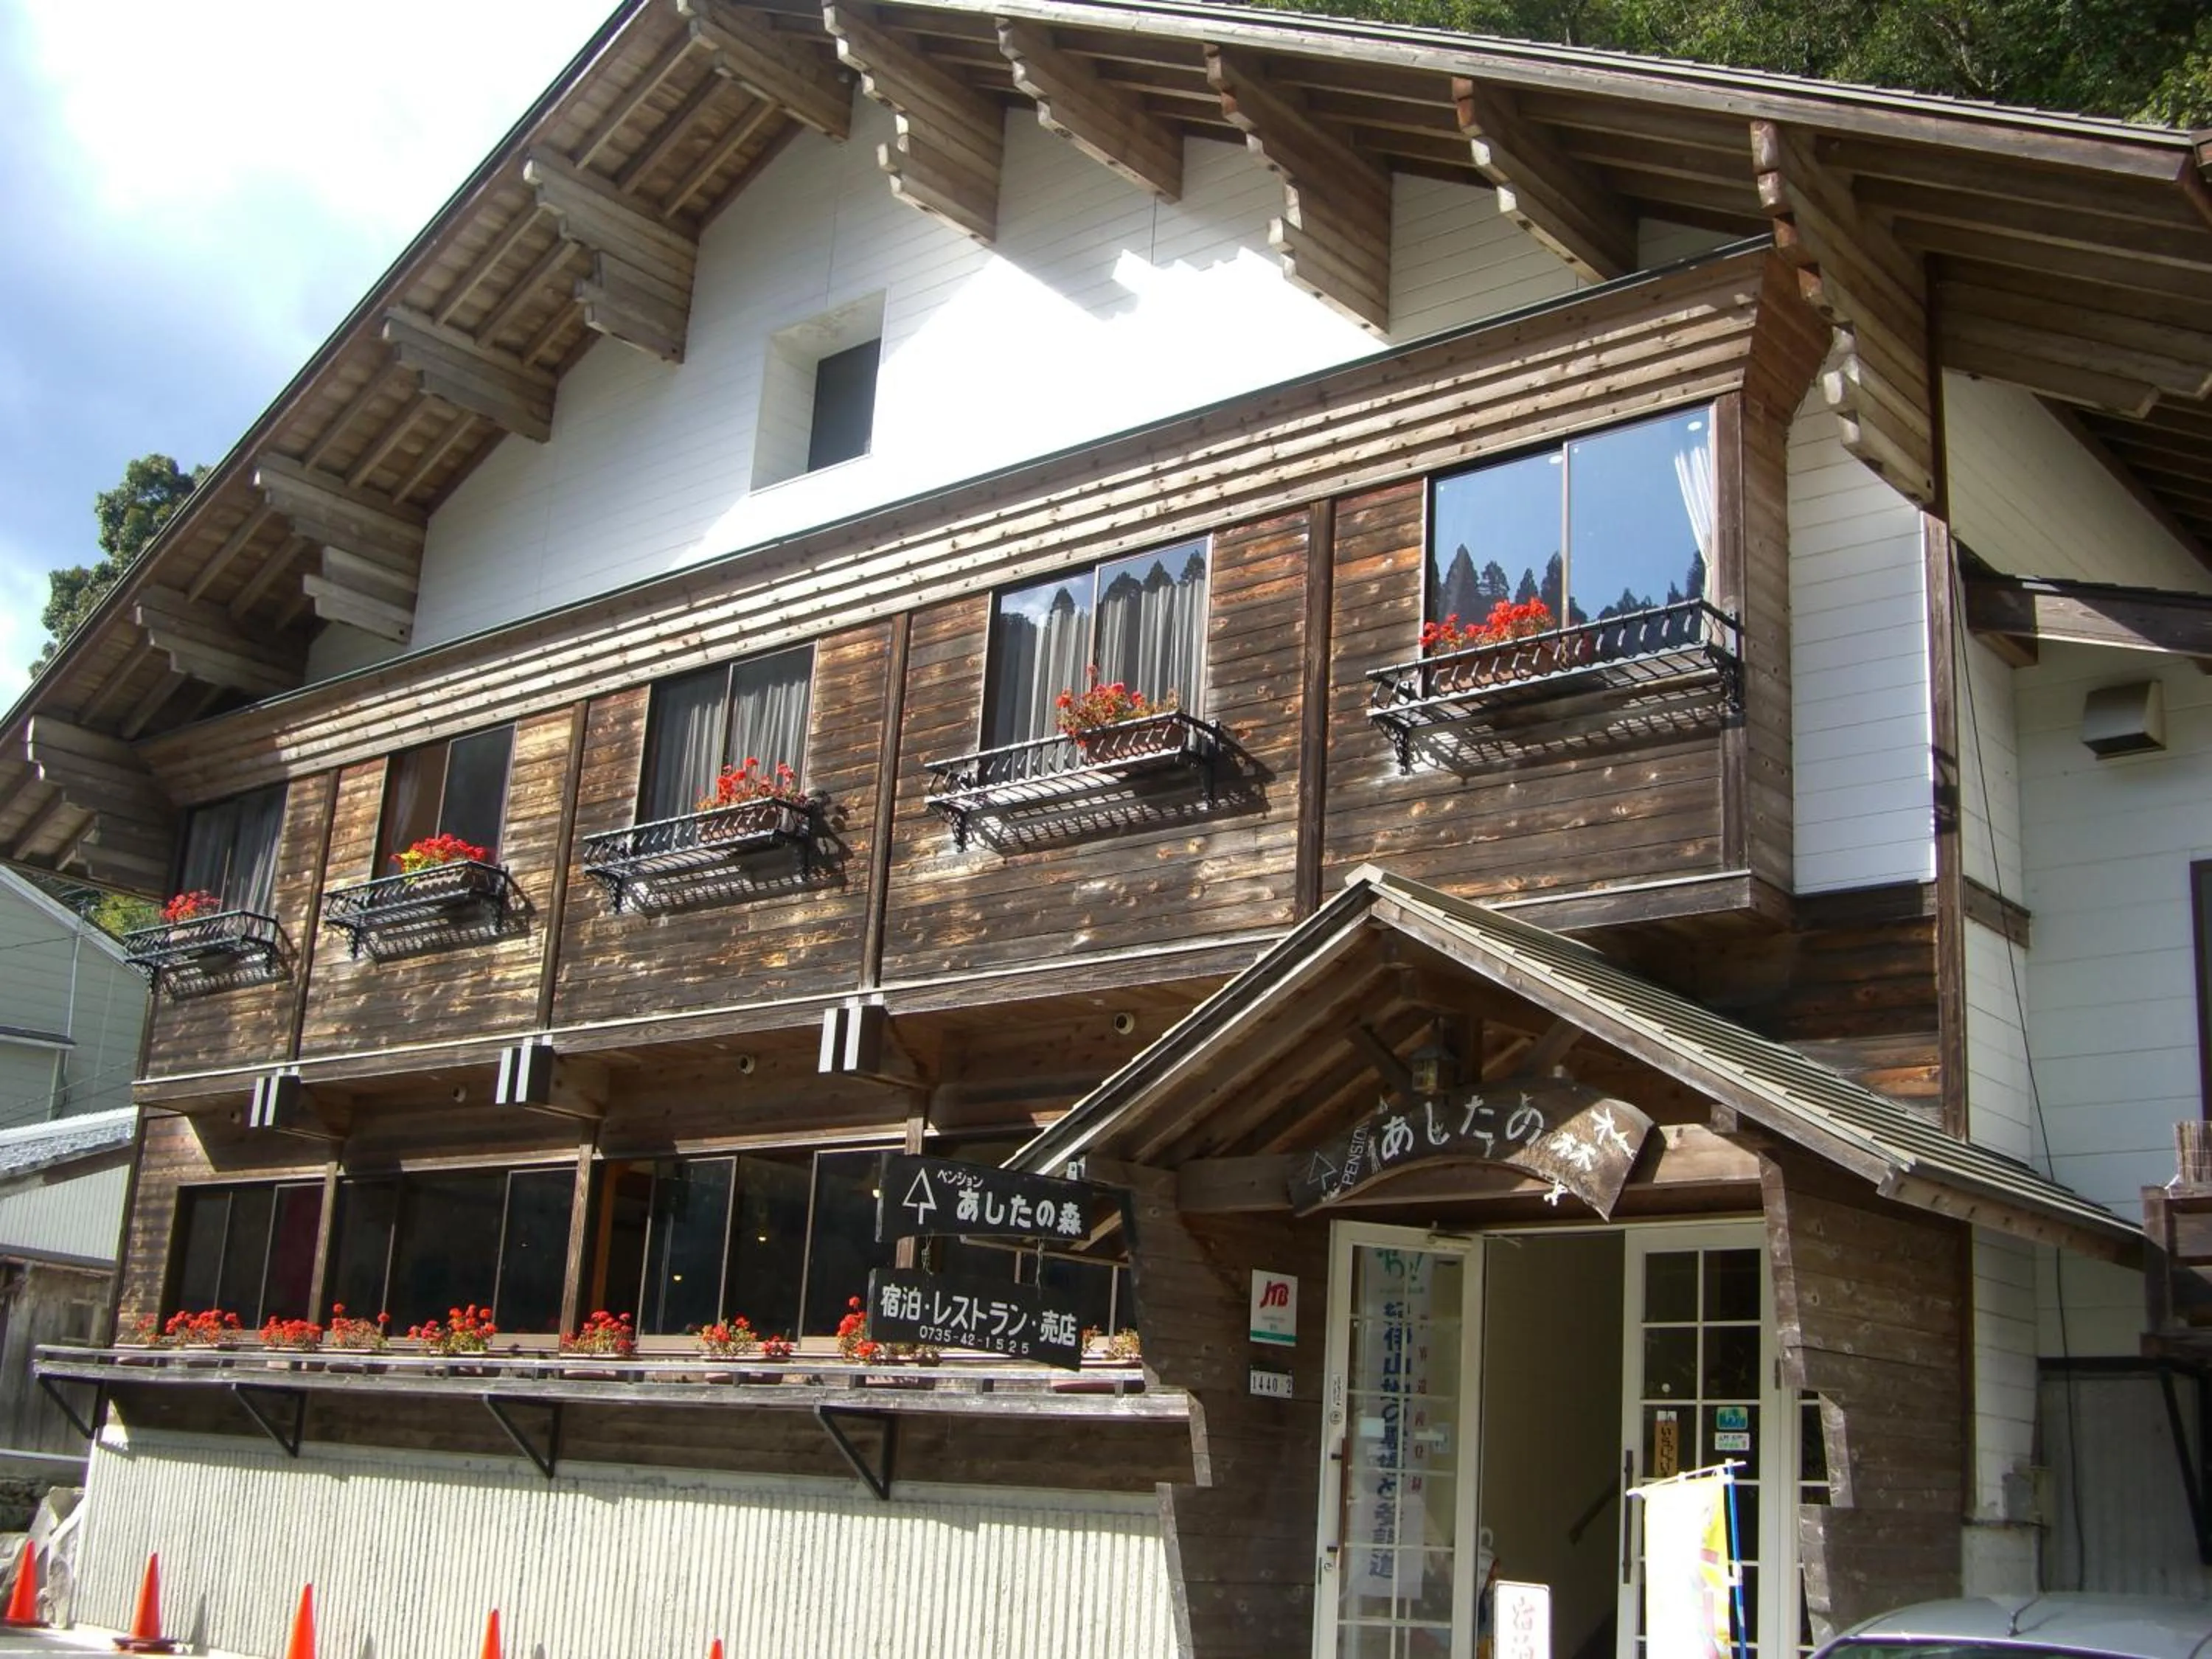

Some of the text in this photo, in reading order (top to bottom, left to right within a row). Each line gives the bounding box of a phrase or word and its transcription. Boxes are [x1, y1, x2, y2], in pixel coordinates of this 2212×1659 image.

[1342, 1121, 1369, 1186] PENSION
[937, 1168, 984, 1189] ペンション
[956, 1187, 1082, 1236] あしたの森
[1259, 1281, 1289, 1309] JTB
[919, 1324, 1029, 1354] 0735-42-1525
